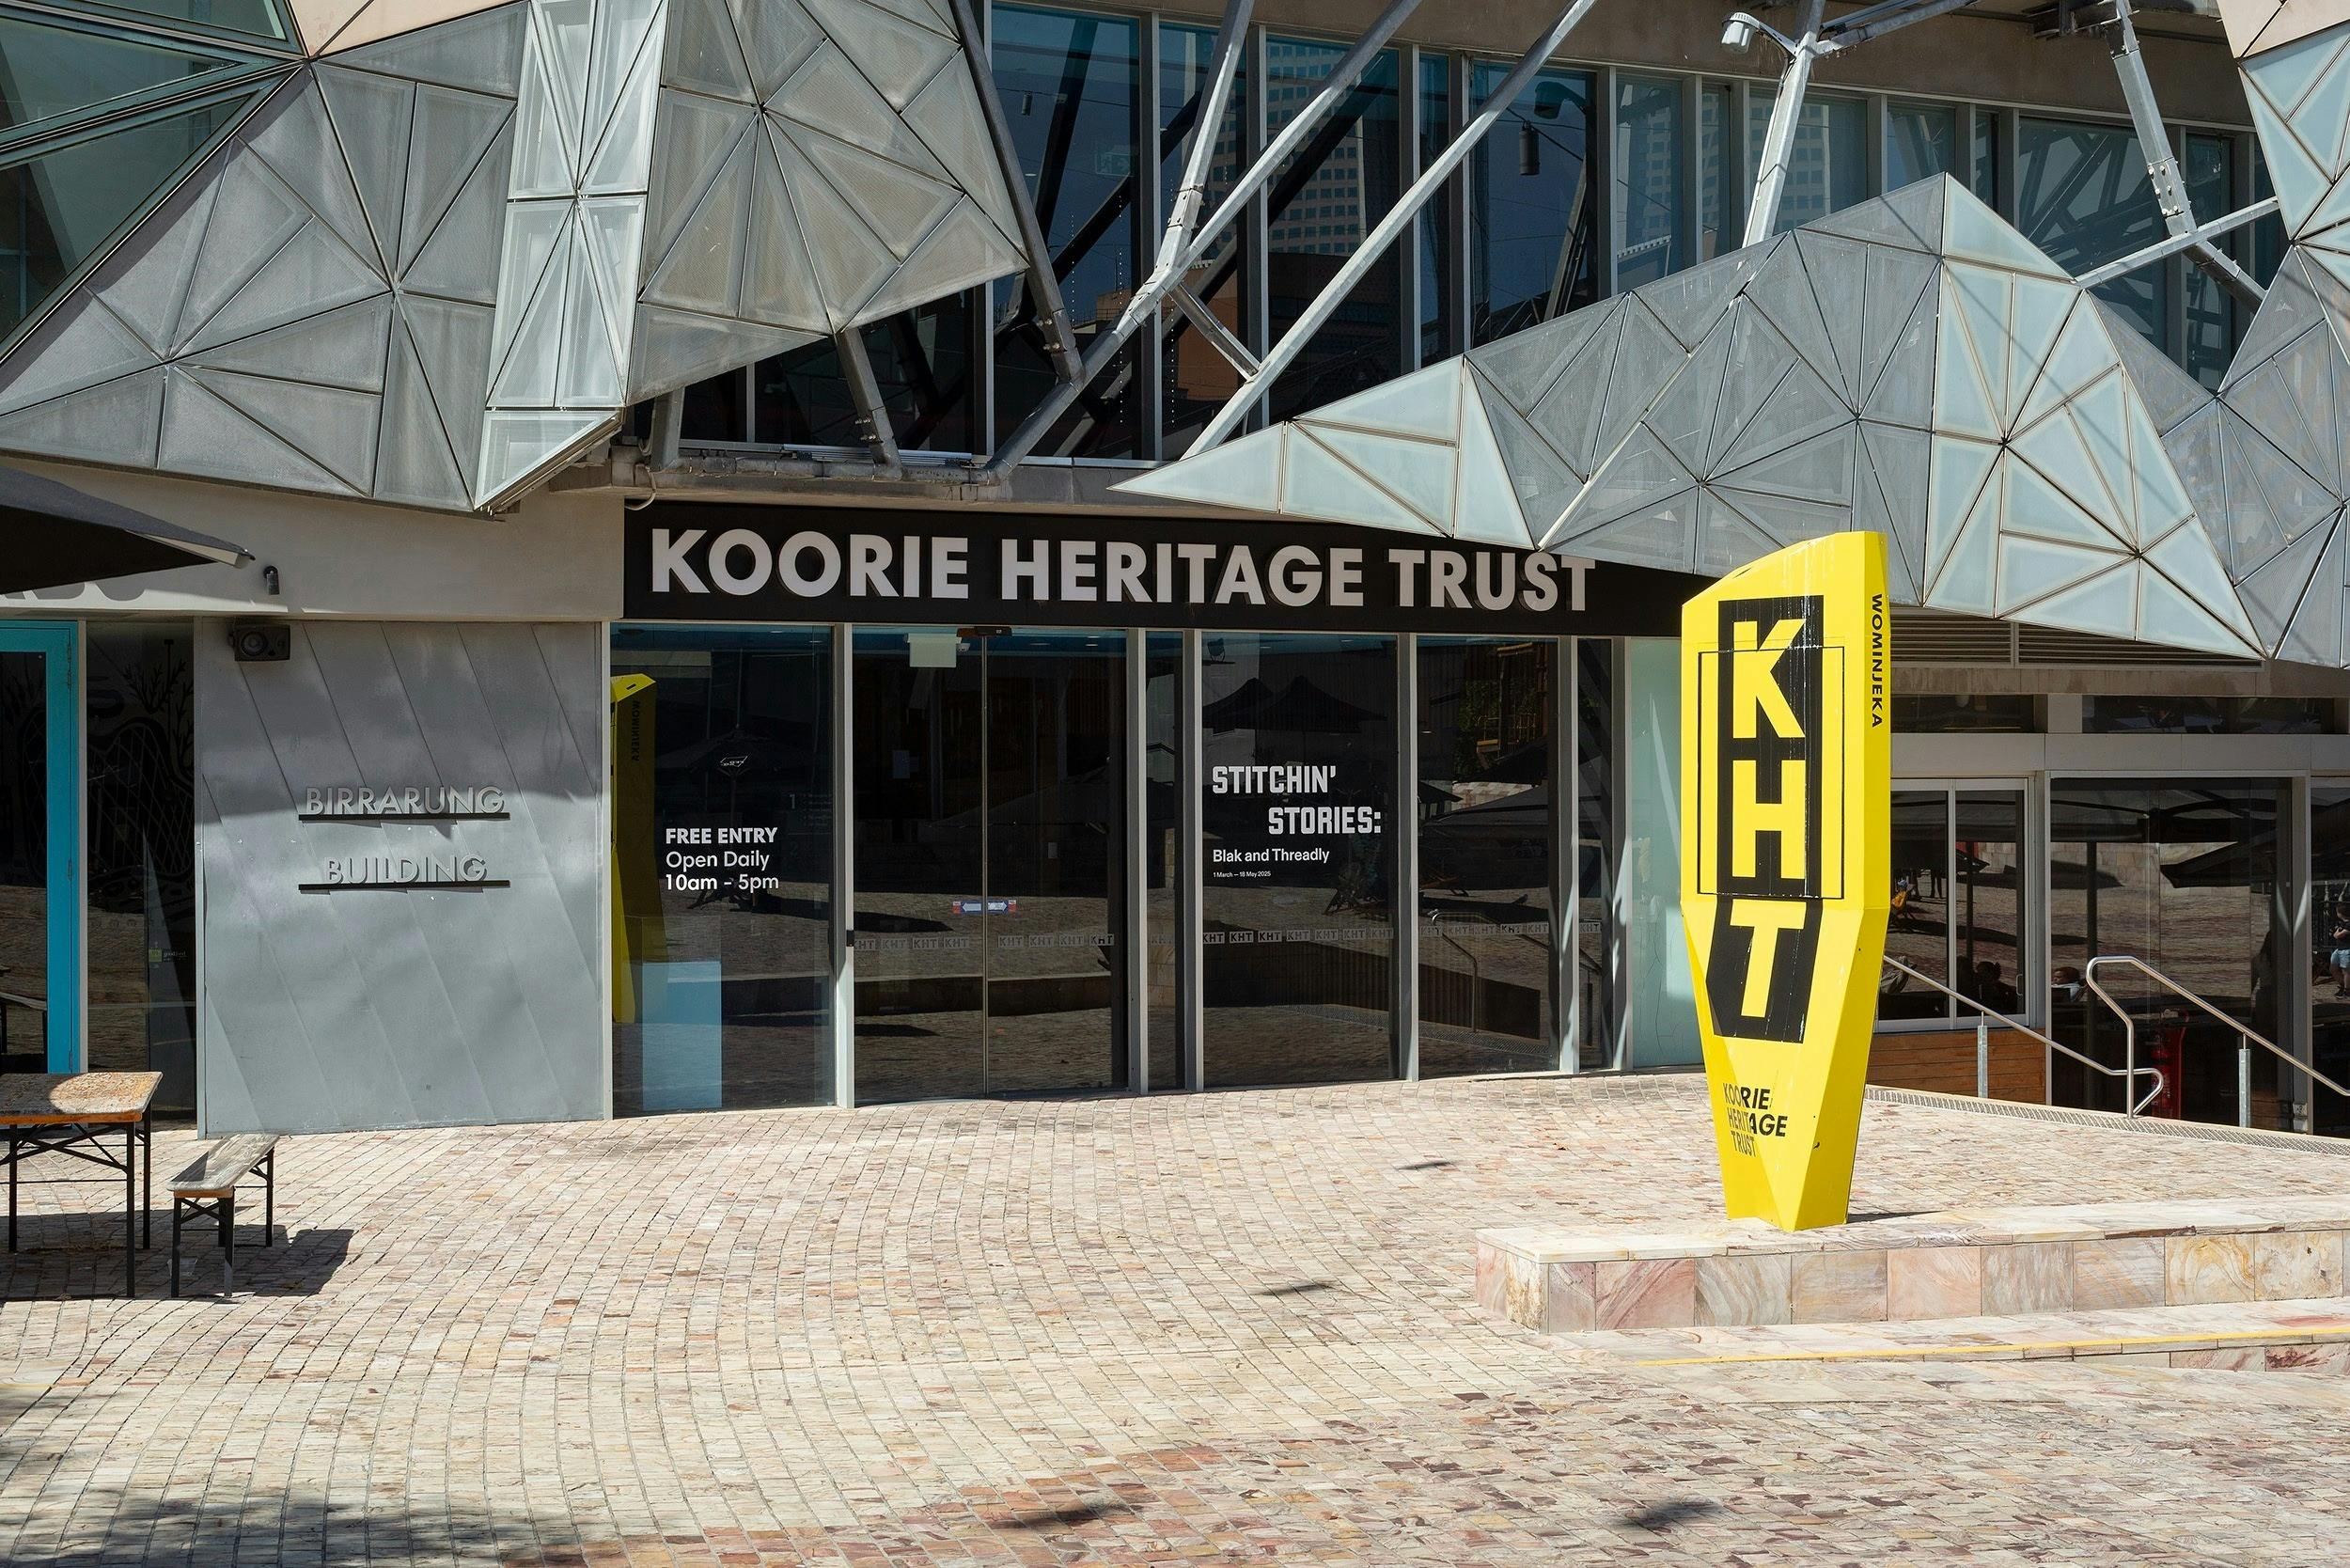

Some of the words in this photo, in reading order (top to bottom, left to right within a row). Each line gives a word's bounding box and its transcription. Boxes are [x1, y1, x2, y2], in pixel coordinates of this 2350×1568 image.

[652, 528, 968, 599] KOORIE
[1001, 539, 1363, 607] HERITAGE
[1388, 548, 1595, 612] TRUST
[1872, 593, 1883, 728] WOMINJEKA
[1213, 765, 1337, 793] STITCHIN'
[306, 786, 506, 814] BIRRARUNG
[1268, 807, 1382, 835] STORIES:
[1731, 619, 1807, 1018] KHT
[666, 828, 713, 844] FREE
[718, 827, 778, 844] ENTRY
[324, 855, 488, 884] BUILDING
[666, 851, 718, 872] Open
[724, 850, 770, 871] Daily
[1213, 849, 1243, 862] Blak
[1245, 848, 1269, 862] and
[1272, 848, 1330, 864] Threadly
[666, 874, 718, 891] 10am
[738, 873, 779, 894] 5pm
[913, 937, 938, 949] KHT
[945, 937, 969, 949] KHT
[999, 936, 1023, 947] KHT
[1029, 935, 1054, 946] KHT
[1060, 934, 1084, 945] KHT
[1230, 933, 1252, 942] KHT
[1259, 932, 1281, 941] KHT
[1288, 931, 1309, 940] KHT
[1316, 930, 1338, 939] KHT
[1344, 930, 1366, 939] KHT
[1723, 1083, 1771, 1110] KOORIE
[1727, 1107, 1788, 1137] HERITAGE
[1731, 1130, 1756, 1157] TRUST
